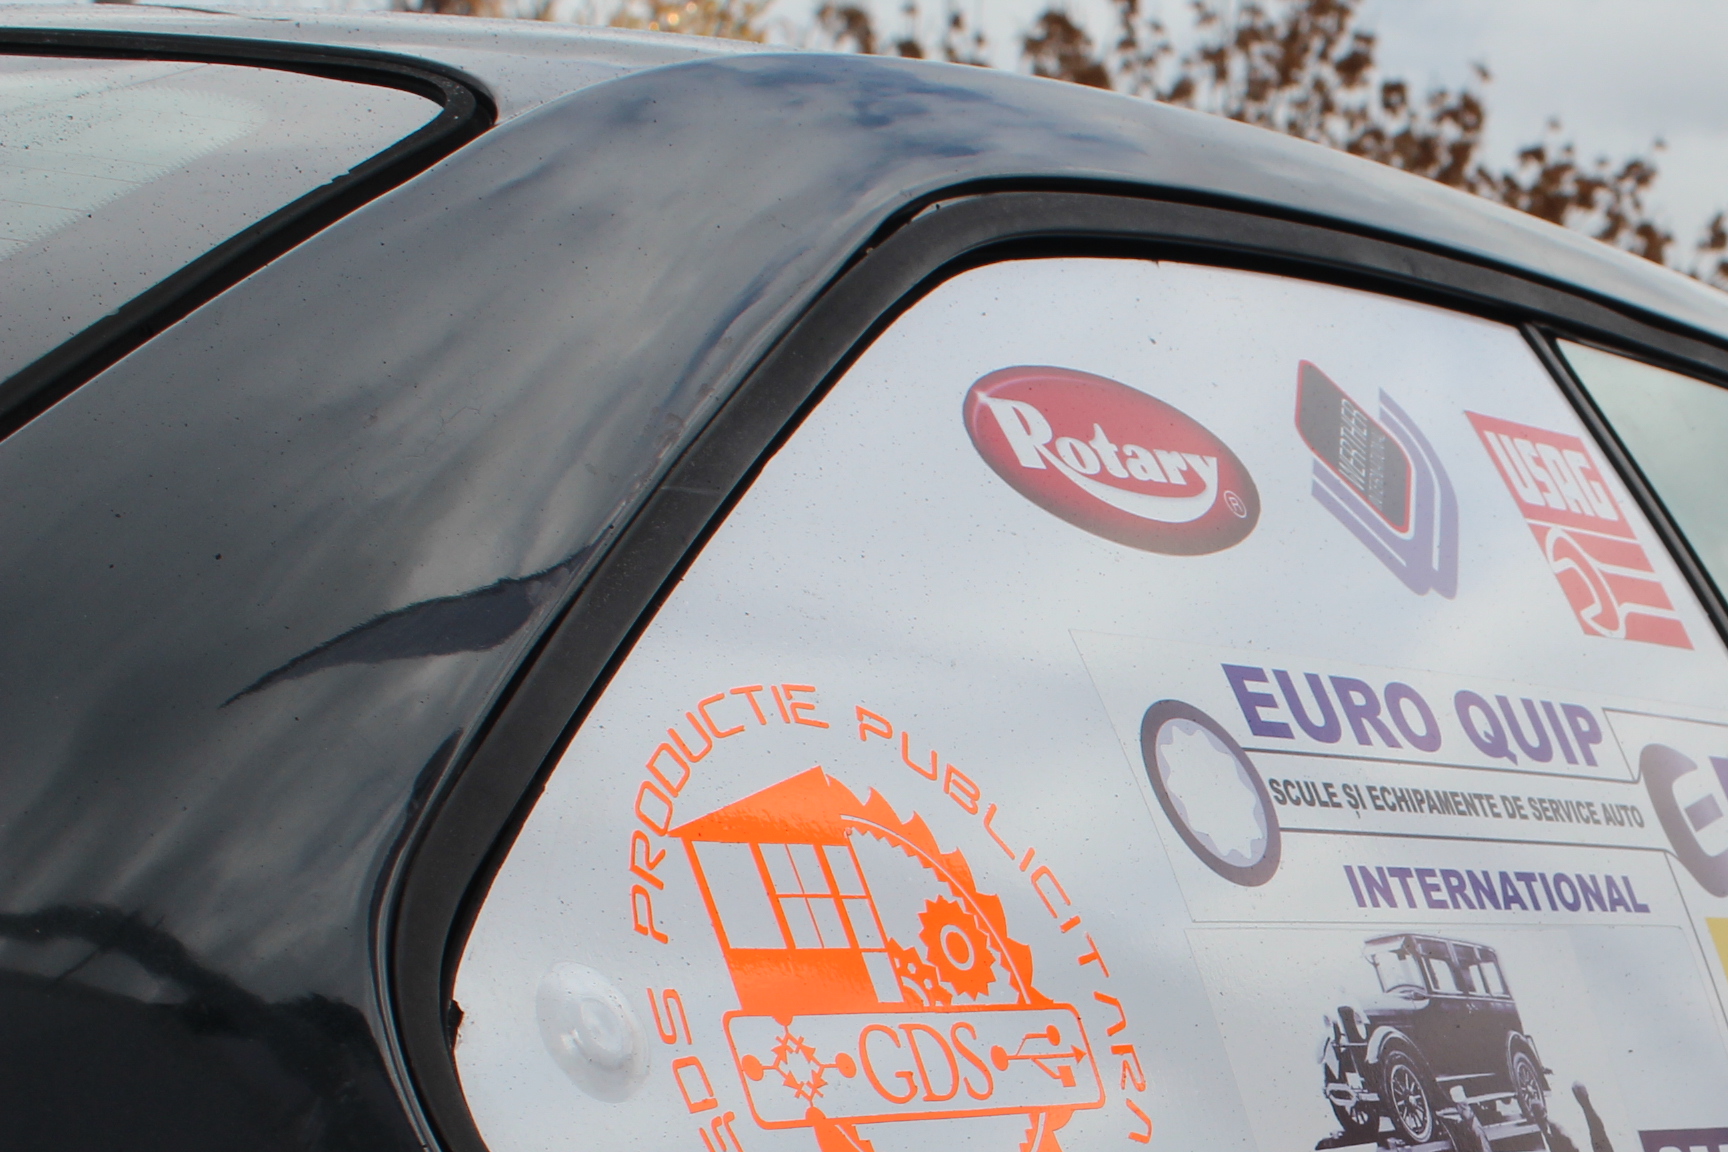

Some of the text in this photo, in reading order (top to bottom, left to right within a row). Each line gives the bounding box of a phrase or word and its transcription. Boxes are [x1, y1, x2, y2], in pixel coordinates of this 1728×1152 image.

[976, 391, 1218, 522] Rotary
[1339, 399, 1368, 491] WERTHER
[1484, 430, 1619, 521] USAG
[1221, 663, 1603, 768] EURO QUIP
[628, 683, 829, 944] PRODUCTIE
[1268, 778, 1343, 808] SCULE
[1372, 787, 1501, 819] ECHIPAMENTE
[1500, 794, 1529, 821] DE
[1530, 797, 1601, 825] SERVICE
[1600, 802, 1645, 828] AUTO
[1345, 865, 1650, 913] INTERNATIONAL
[859, 1021, 994, 1104] GDS
